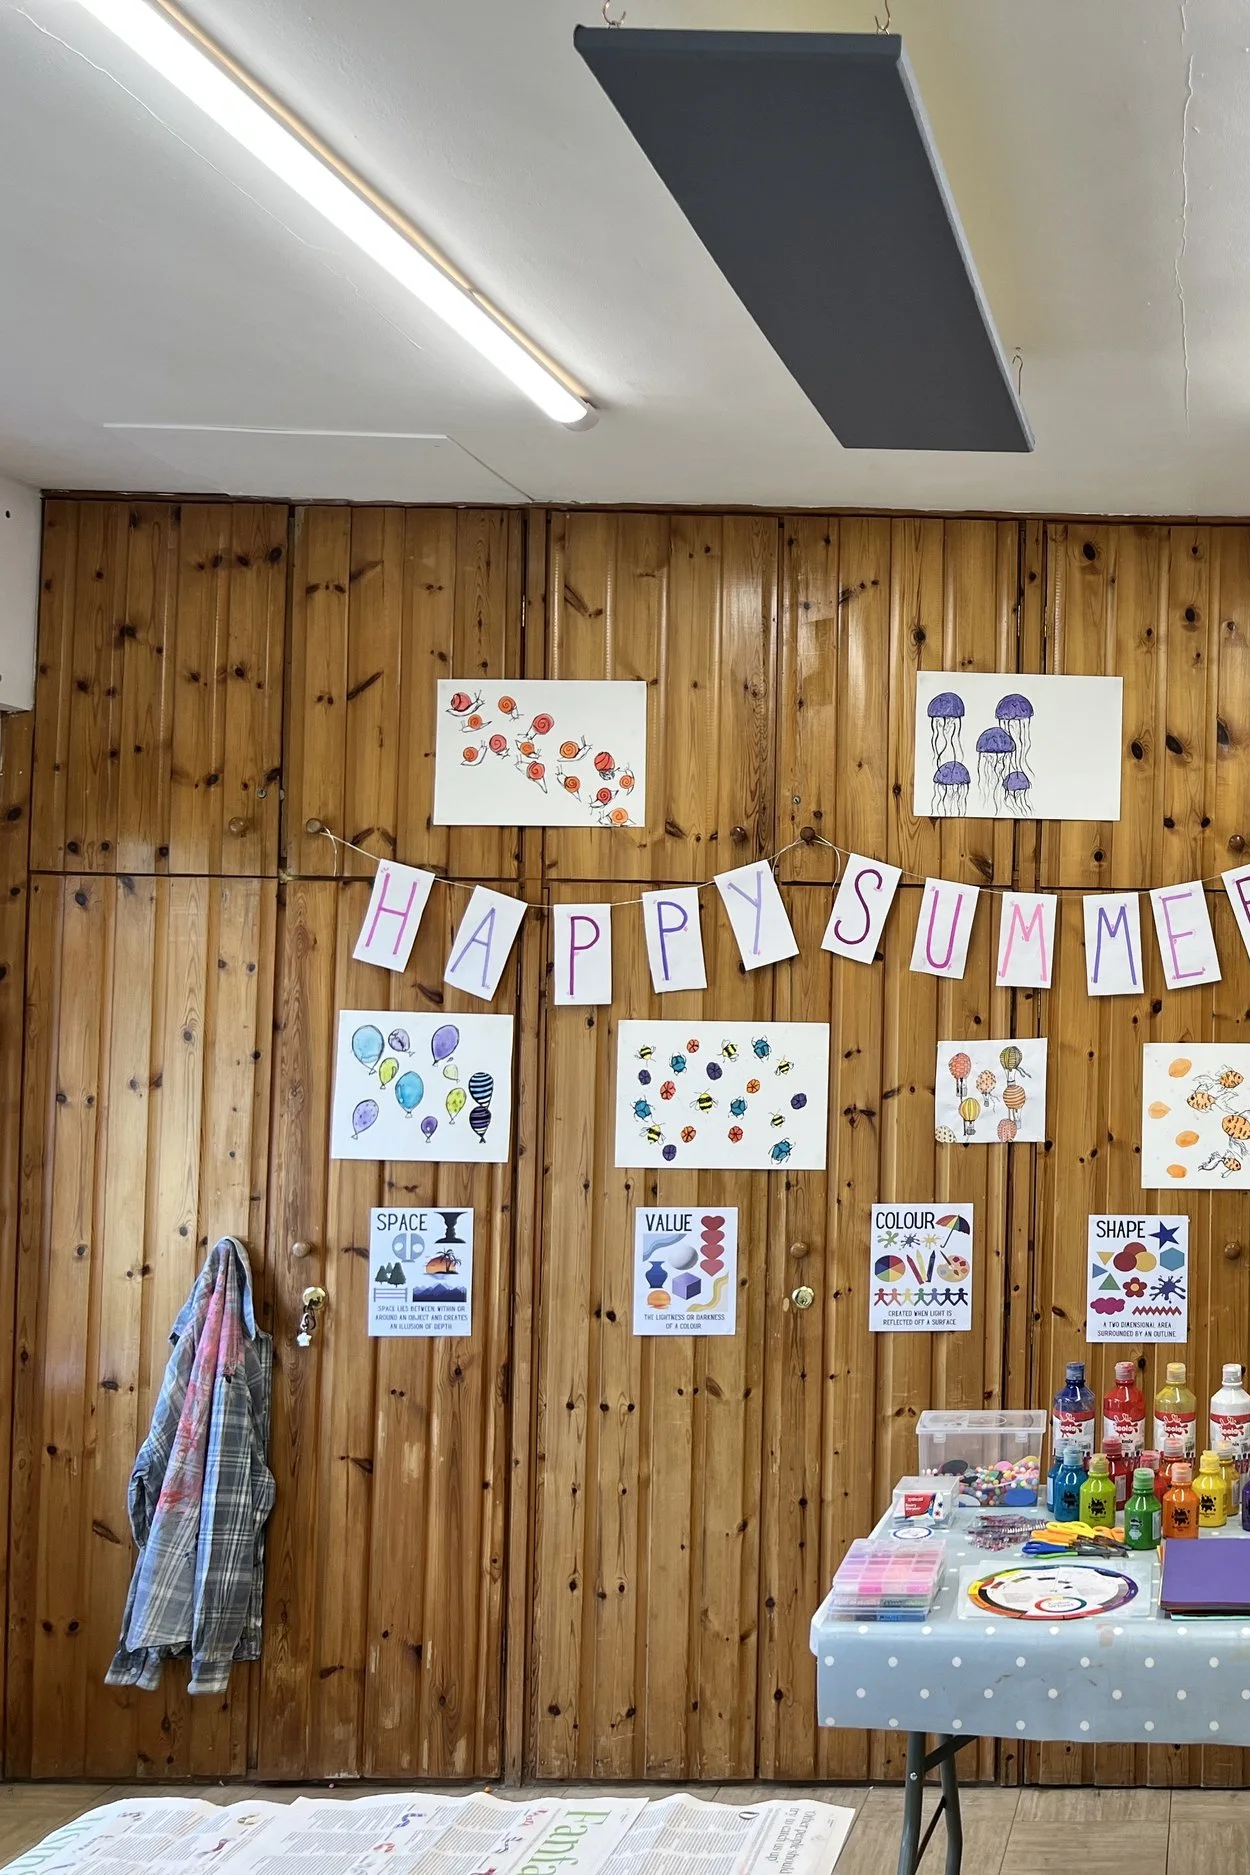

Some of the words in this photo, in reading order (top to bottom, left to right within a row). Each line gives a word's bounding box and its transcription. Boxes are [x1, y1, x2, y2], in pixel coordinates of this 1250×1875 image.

[365, 869, 765, 997] HAPPY
[376, 1213, 428, 1231] SPACE
[645, 1214, 693, 1232] VALUE
[876, 1211, 935, 1229] COLOUR
[1096, 1220, 1146, 1238] SHAPE
